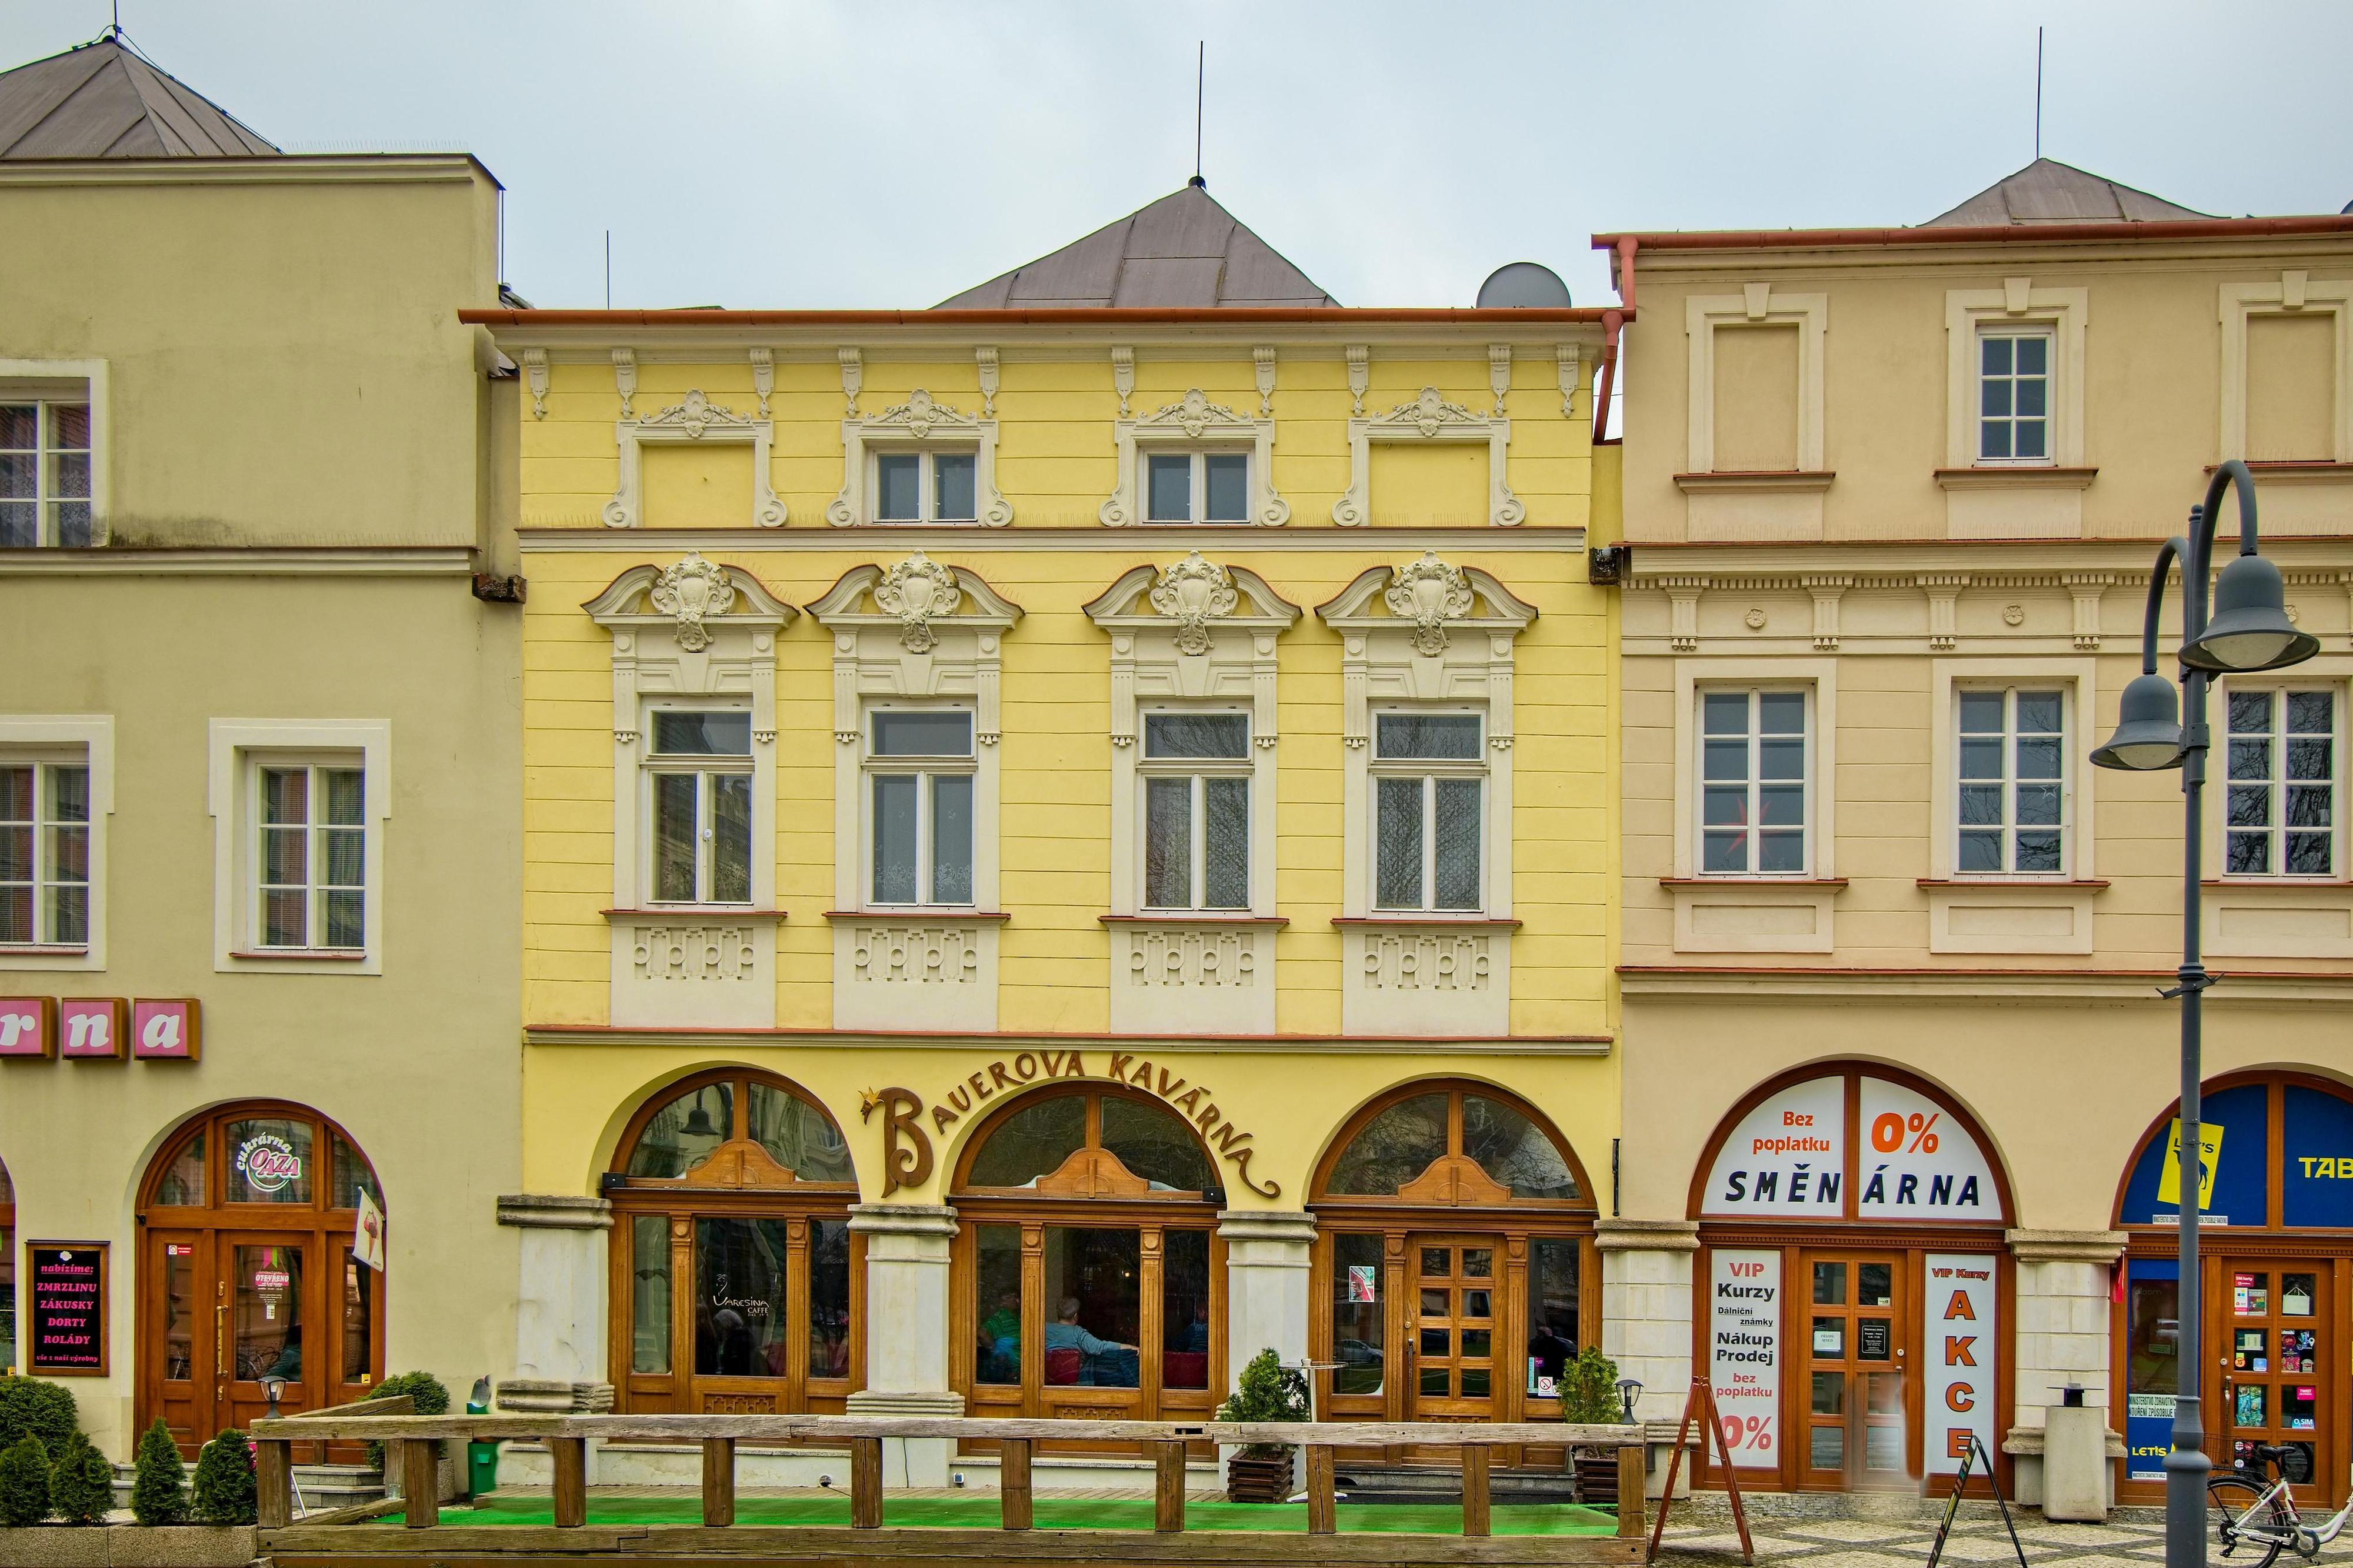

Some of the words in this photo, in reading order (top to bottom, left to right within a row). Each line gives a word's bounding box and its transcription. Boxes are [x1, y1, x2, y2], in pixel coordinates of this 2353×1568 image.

[879, 1050, 1085, 1198] BAUEROVA
[1108, 1051, 1281, 1199] KAVÁRNA
[1783, 1111, 1814, 1126] Bez
[1871, 1112, 1939, 1154] 0%
[236, 1132, 292, 1170] cukrárna
[1752, 1136, 1829, 1155] poplatku
[41, 1264, 94, 1273] nabízíme:
[1729, 1263, 1764, 1277] VIP
[1932, 1268, 1952, 1278] VIP
[1956, 1269, 1990, 1281] Kurzy
[36, 1283, 97, 1292] ZMRZLINU
[1718, 1283, 1775, 1302] Kurzy
[39, 1298, 94, 1310] ZÁKUSKY
[1718, 1307, 1753, 1315] Dálniční
[48, 1318, 86, 1327] DORTY
[1740, 1318, 1773, 1327] známky
[44, 1334, 91, 1345] ROLÁDY
[1717, 1332, 1773, 1349] Nákup
[70, 1355, 98, 1363] výrobny
[1717, 1349, 1773, 1366] Prodej
[1733, 1373, 1756, 1383] bez
[1943, 1290, 1978, 1459] AKCE
[1716, 1386, 1772, 1399] poplatku
[1719, 1415, 1772, 1450] 0%
